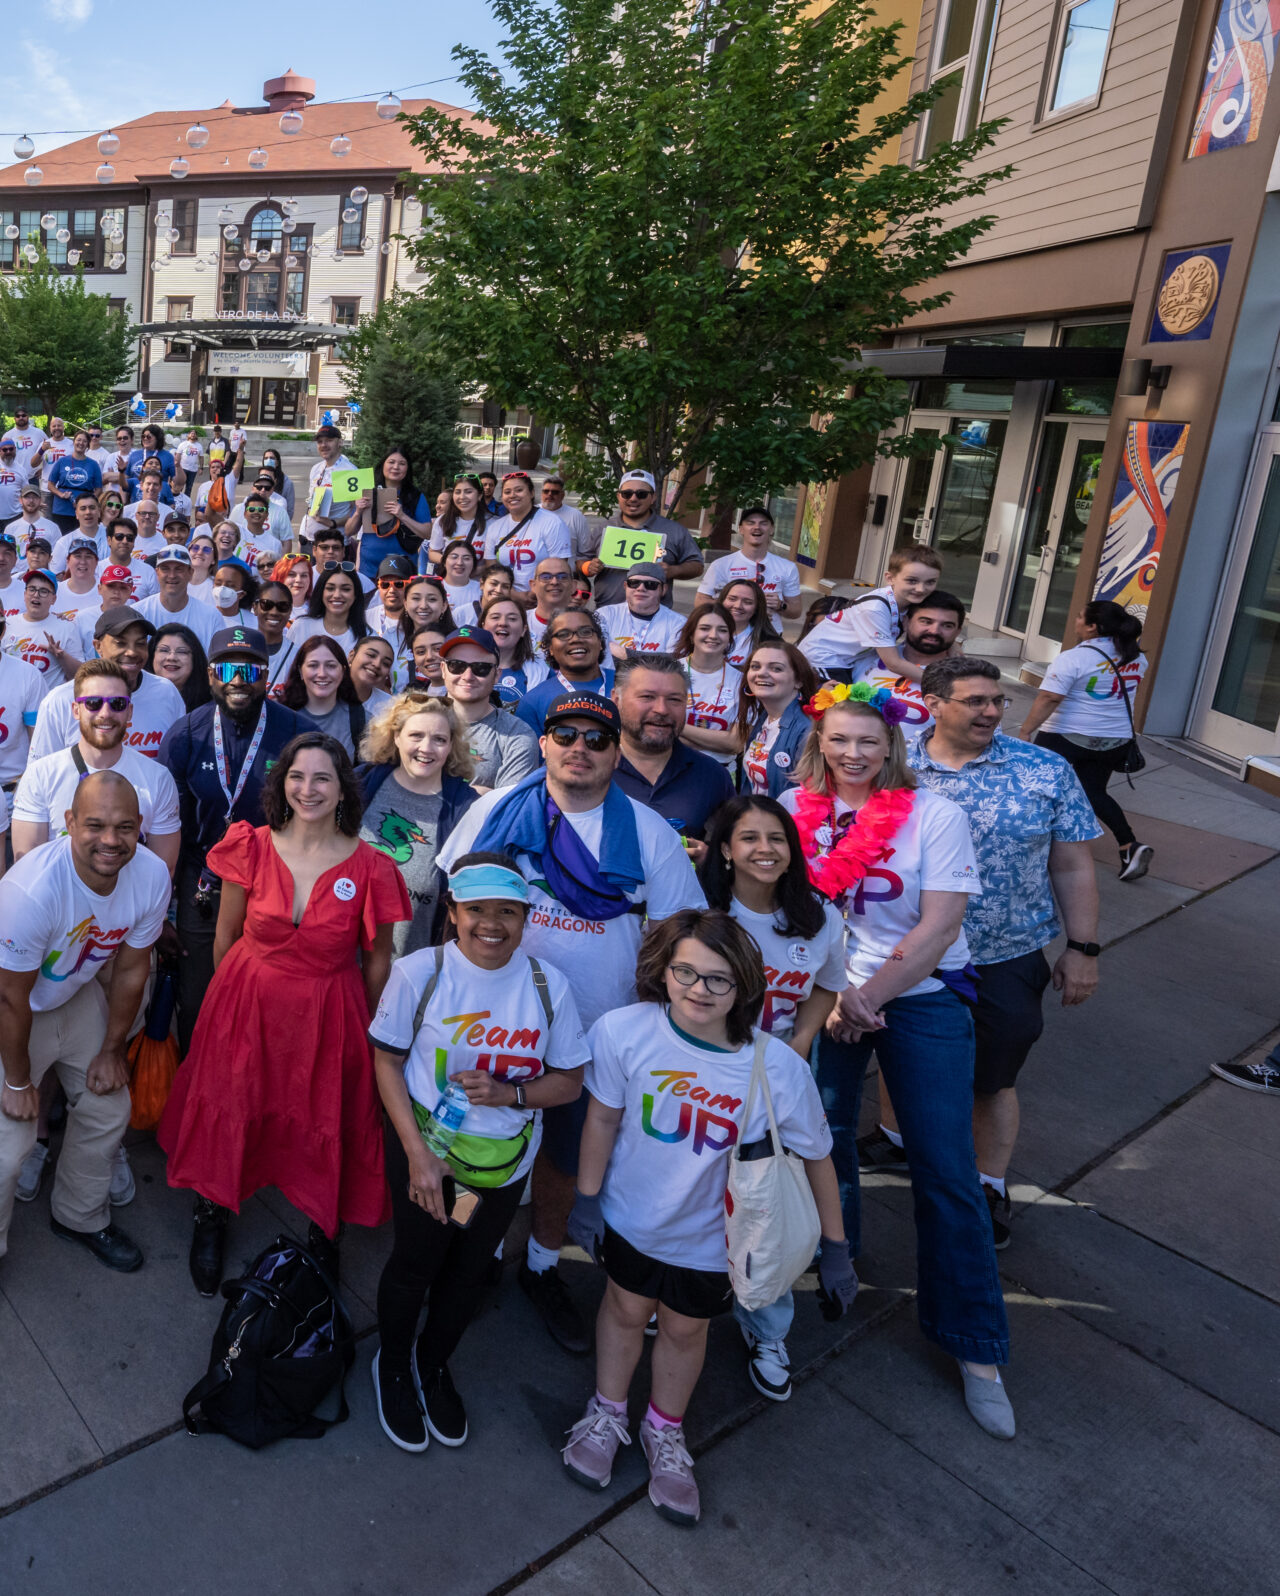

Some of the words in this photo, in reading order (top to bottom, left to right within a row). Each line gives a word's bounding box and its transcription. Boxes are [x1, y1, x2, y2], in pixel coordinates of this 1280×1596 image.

[247, 310, 262, 320] DE
[266, 311, 279, 320] LA
[16, 439, 34, 450] UP
[346, 476, 359, 493] 8
[614, 539, 646, 561] 16
[556, 701, 614, 719] DRAGONS
[531, 911, 606, 935] DRAGONS
[441, 1010, 541, 1051] Team
[650, 1069, 743, 1115] Team
[641, 1092, 739, 1157] UP
